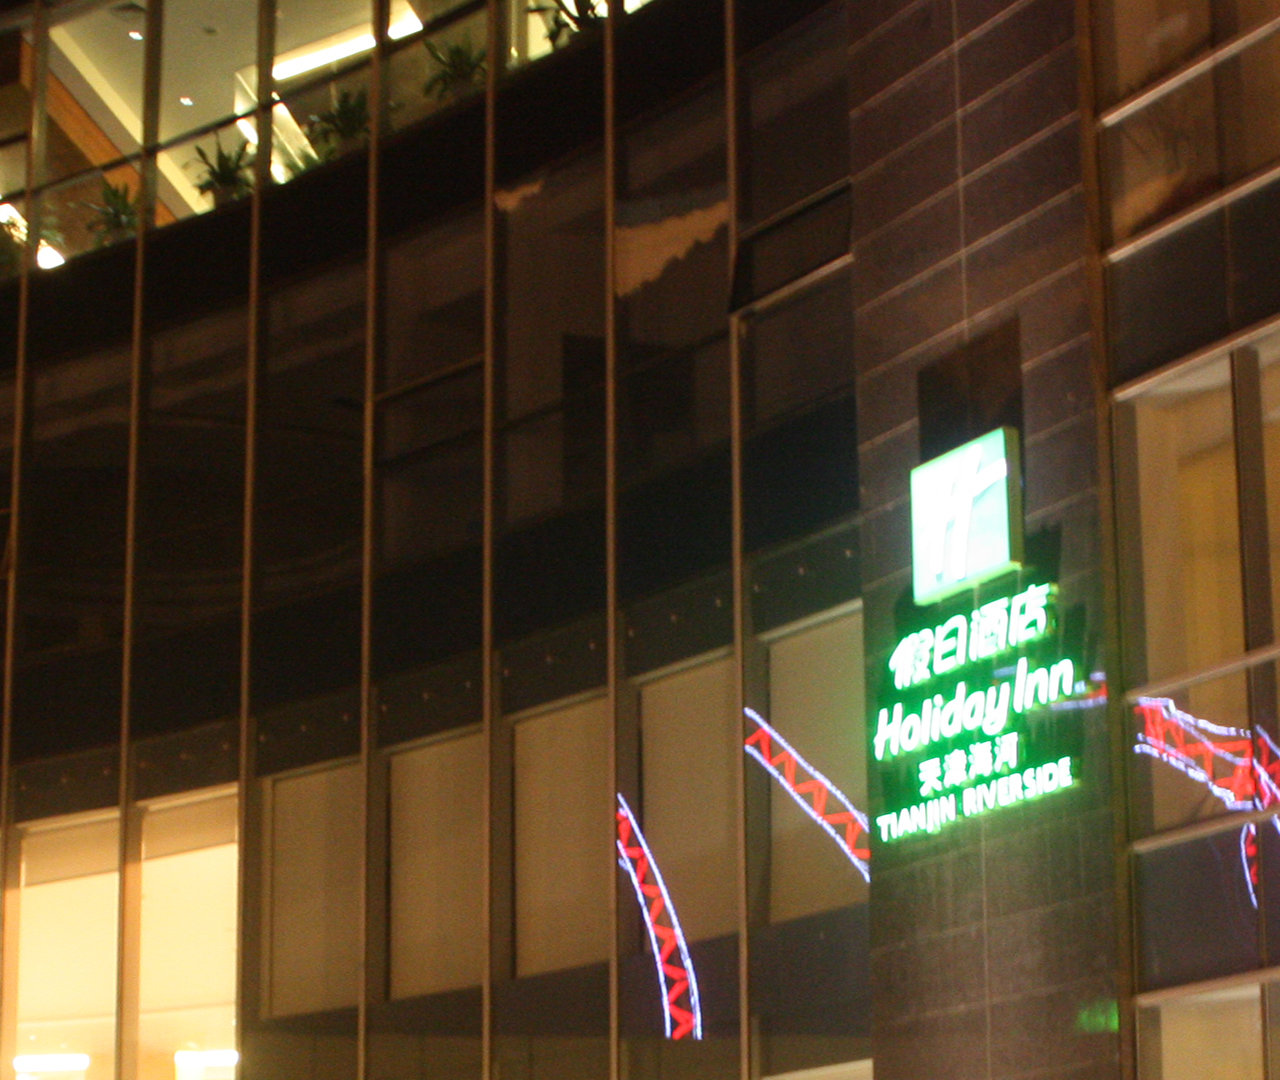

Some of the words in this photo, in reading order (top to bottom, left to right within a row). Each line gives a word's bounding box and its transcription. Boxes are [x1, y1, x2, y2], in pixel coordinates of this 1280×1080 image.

[890, 584, 1049, 689] 假日酒店
[874, 681, 1010, 760] Holiday
[1014, 657, 1074, 713] Inn
[876, 793, 956, 843] TIANJIN
[963, 756, 1072, 816] RIVERSIDE
